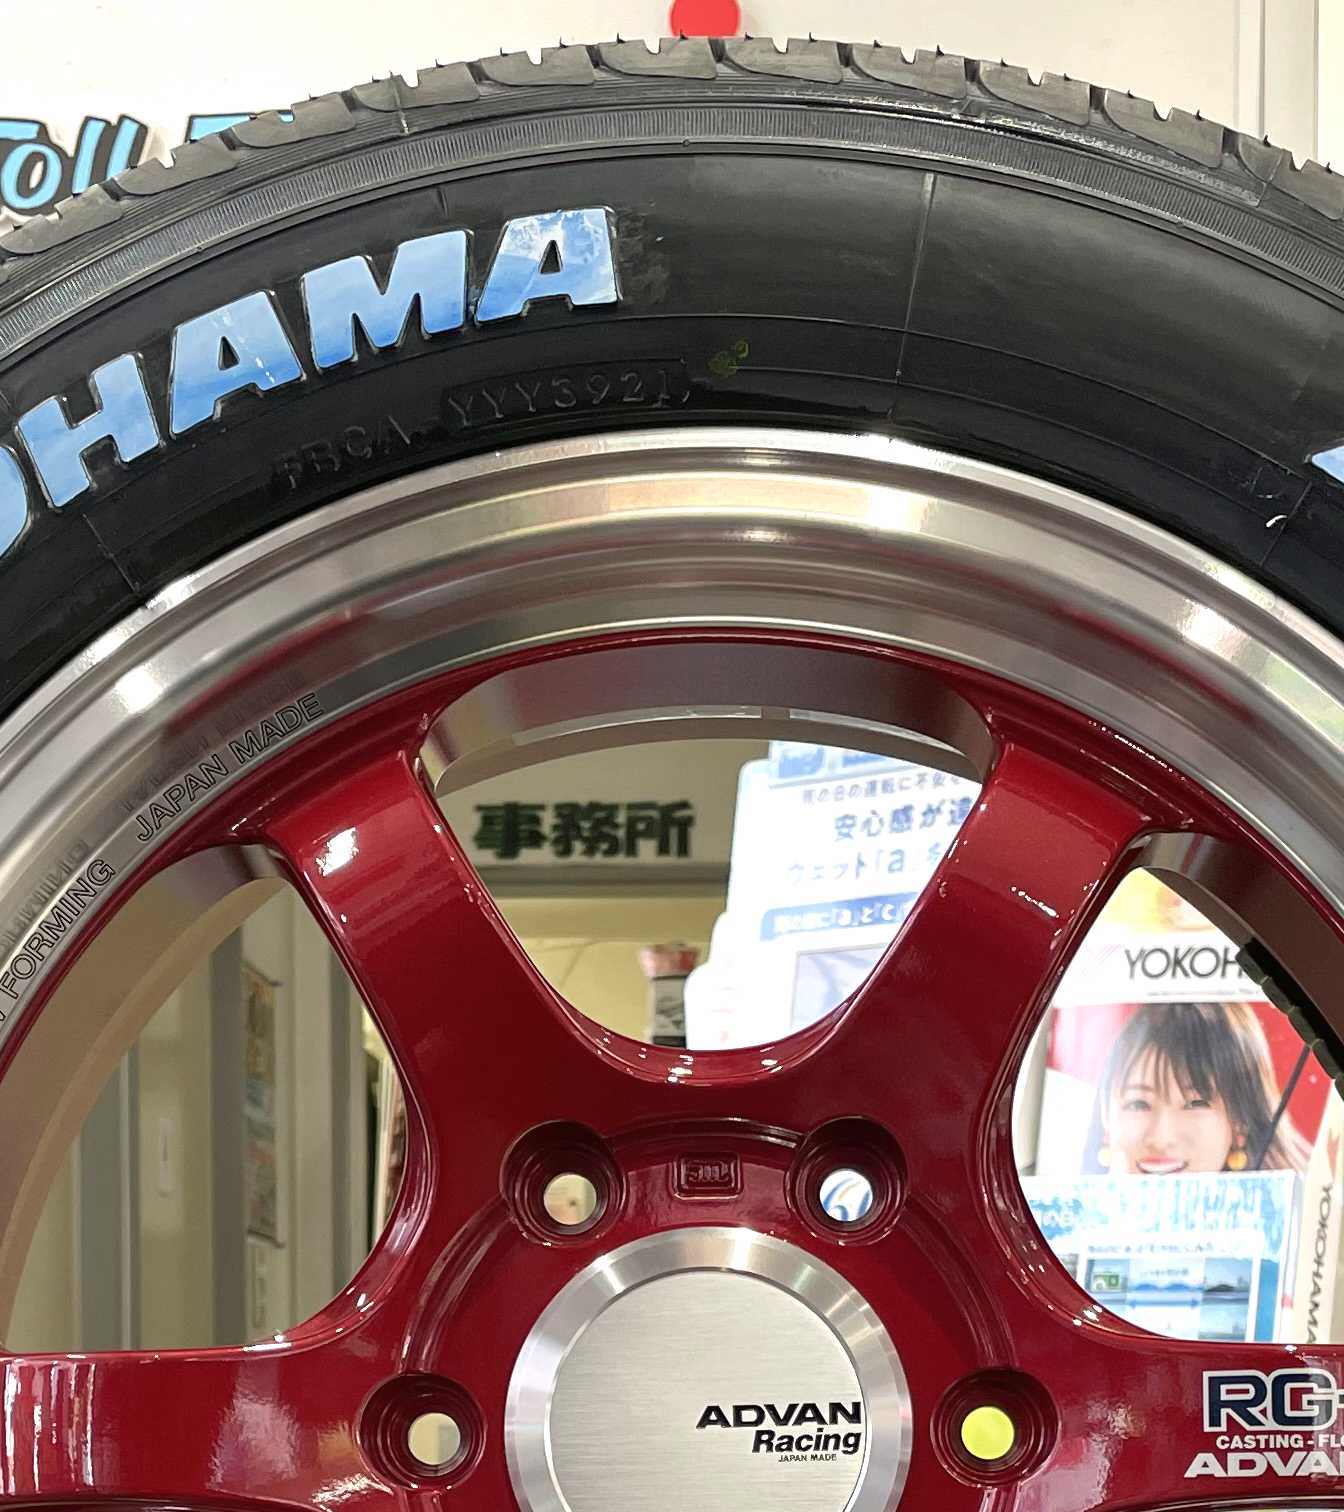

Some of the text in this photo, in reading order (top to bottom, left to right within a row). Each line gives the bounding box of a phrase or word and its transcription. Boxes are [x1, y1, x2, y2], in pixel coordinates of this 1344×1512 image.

[136, 753, 231, 843] JAPAN
[229, 692, 326, 765] MADE
[472, 801, 696, 859] 事務所
[1125, 946, 1246, 980] YOKOH
[696, 1402, 861, 1429] ADVAN
[751, 1428, 862, 1456] Racing
[1216, 1434, 1304, 1450] CASTING
[778, 1454, 837, 1463] JAPAN MADE
